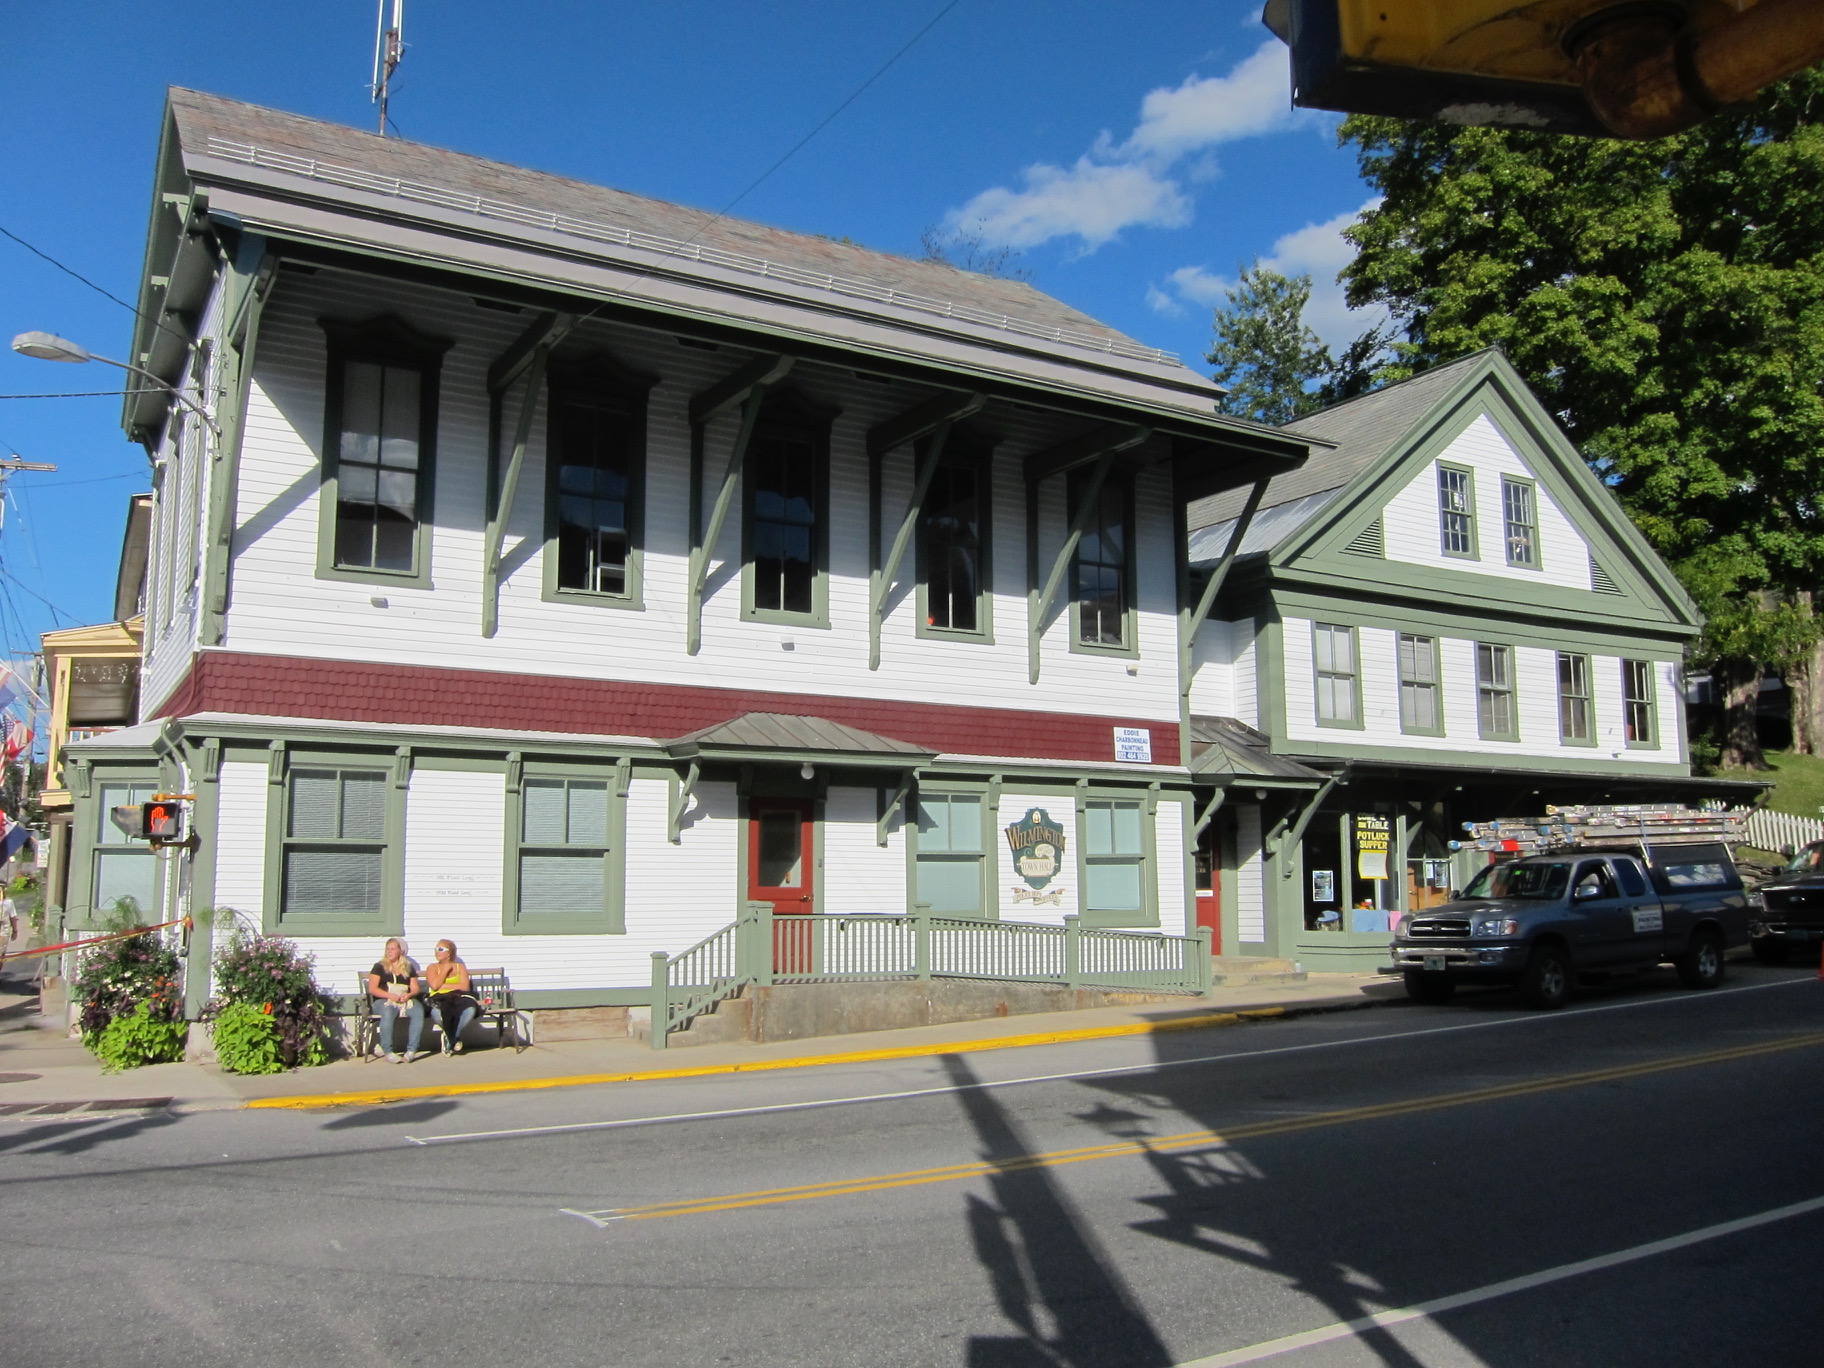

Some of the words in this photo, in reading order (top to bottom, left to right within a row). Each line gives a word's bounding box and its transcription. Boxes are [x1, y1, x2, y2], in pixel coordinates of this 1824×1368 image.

[1116, 736, 1148, 744] CHARBONNEAU
[1367, 821, 1388, 829] TABLE
[1357, 831, 1390, 840] POTLUCK
[1359, 840, 1388, 849] SUPPER
[1022, 862, 1038, 871] TOWN
[1039, 862, 1052, 871] HALL
